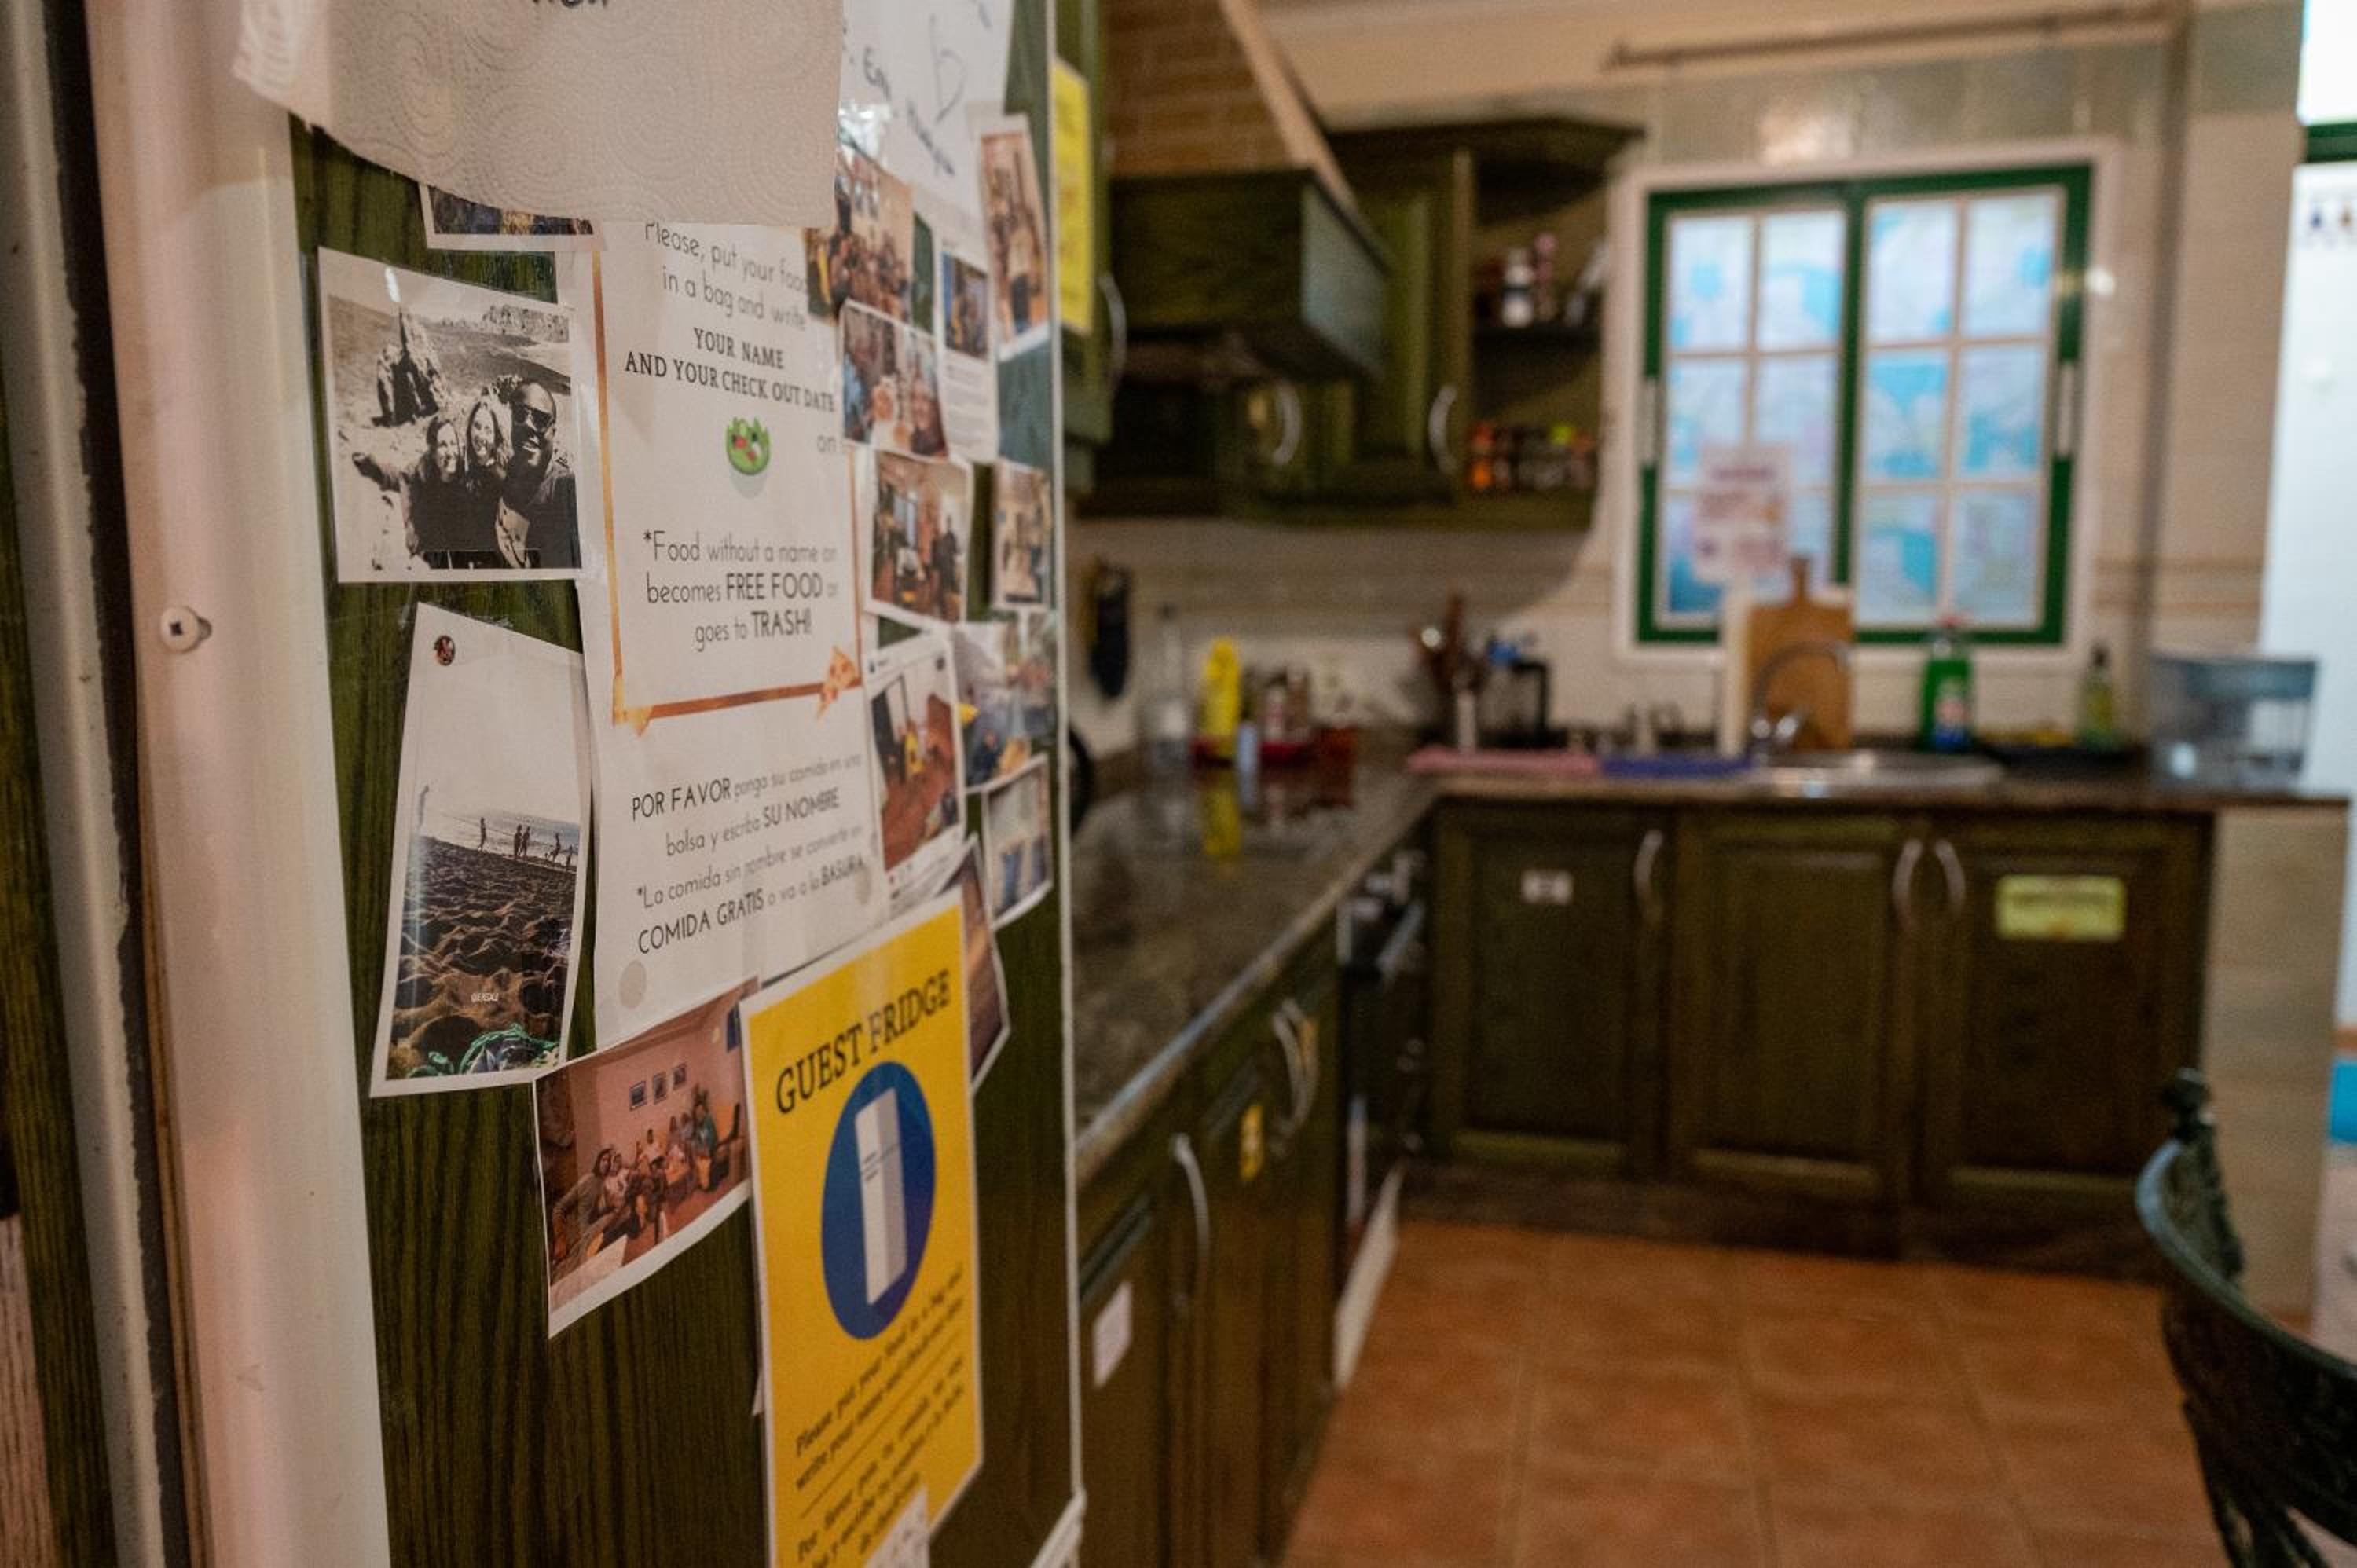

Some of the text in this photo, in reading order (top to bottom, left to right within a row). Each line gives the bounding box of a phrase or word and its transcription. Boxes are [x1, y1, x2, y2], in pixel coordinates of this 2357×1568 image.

[711, 244, 738, 273] put
[742, 258, 774, 283] your
[662, 265, 679, 293] in
[684, 278, 696, 298] a
[703, 270, 733, 317] bag
[738, 289, 764, 319] and
[694, 327, 785, 370] YOUR NAME
[624, 350, 834, 412] AND YOUR CHECK OUT DATE
[708, 532, 760, 562] without
[764, 545, 775, 562] a
[779, 545, 818, 563] name
[647, 571, 722, 603] becomes
[726, 572, 766, 600] FREE
[771, 572, 824, 599] FOOD
[695, 607, 812, 652] goes to TRASH!
[632, 790, 665, 822] POR
[672, 777, 731, 812] FAVOR
[666, 826, 705, 857] bolsa
[710, 831, 719, 854] y
[763, 803, 782, 828] SU
[786, 786, 840, 822] NOMBRE
[668, 864, 721, 901] comida
[725, 866, 742, 883] sin
[746, 844, 787, 874] nombre
[638, 909, 711, 954] COMIDA
[717, 888, 764, 925] GRATIS
[768, 892, 776, 906] o
[780, 885, 796, 900] va
[798, 881, 808, 896] a
[821, 852, 865, 887] BASURA
[775, 968, 951, 1115] GUEST FRIDGE
